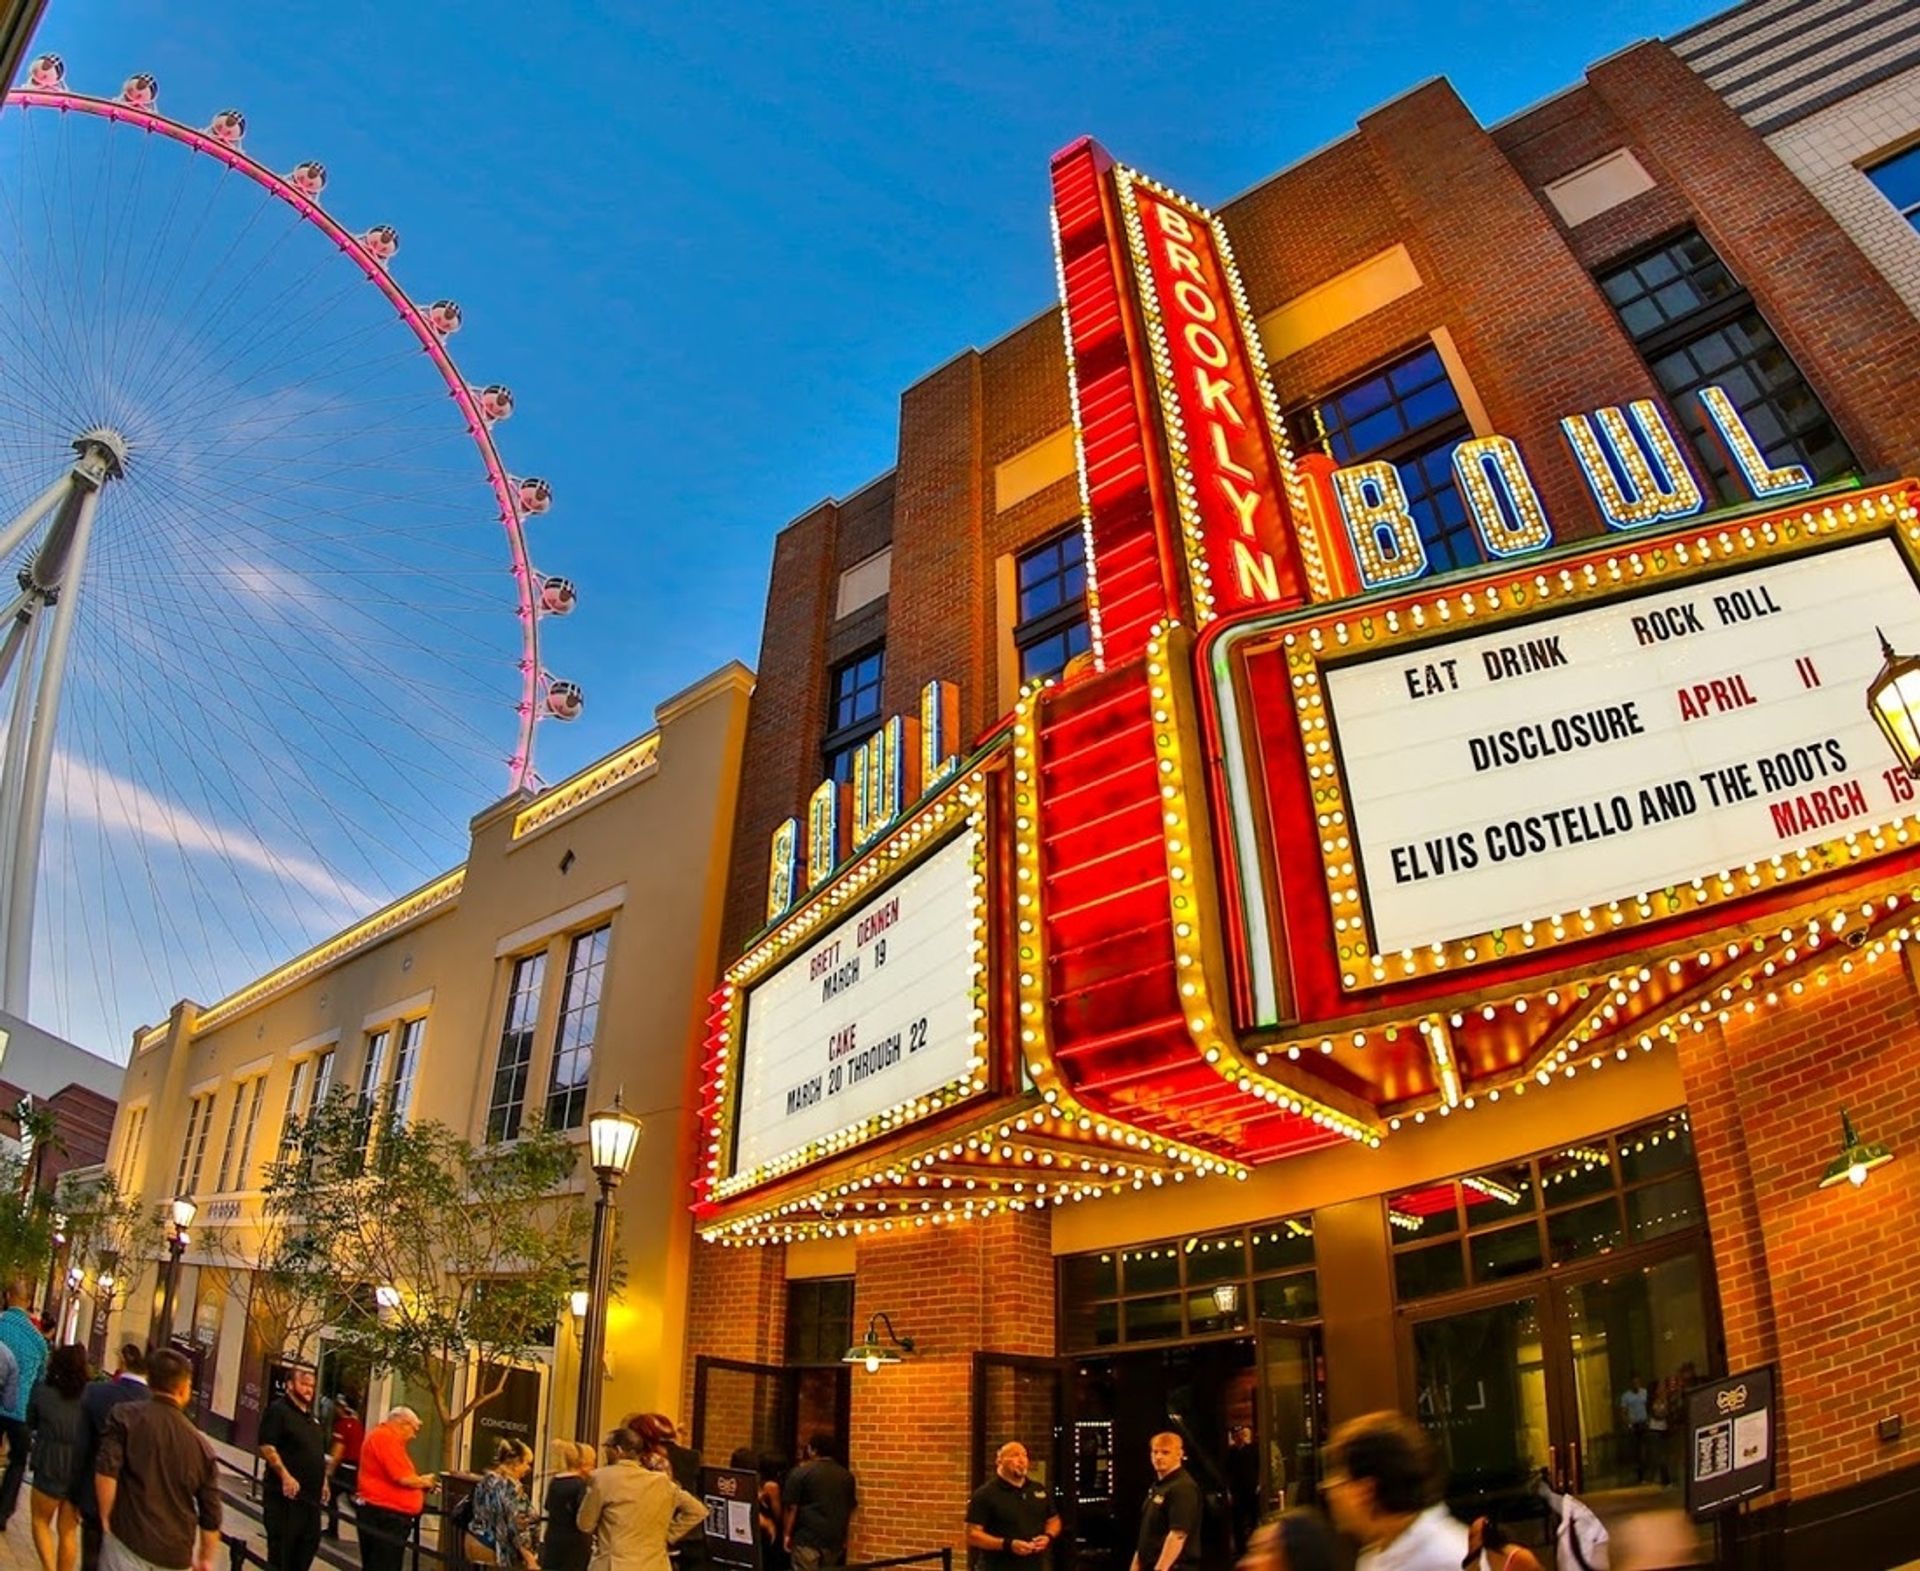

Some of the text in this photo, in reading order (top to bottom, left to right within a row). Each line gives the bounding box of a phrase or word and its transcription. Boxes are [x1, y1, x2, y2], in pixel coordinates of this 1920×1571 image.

[1155, 203, 1280, 600] BROOKLYN
[1331, 386, 1814, 590] BOWL
[1404, 586, 1781, 699] EAT DRINK ROCK ROLL
[1468, 702, 1645, 771] DISCLOSURE
[1677, 675, 1757, 721] APRIL
[766, 680, 958, 928] BOWL
[1390, 739, 1847, 884] ELVIS COSTELLO AND THE ROOTS
[1770, 766, 1914, 839] MARCH 15
[810, 896, 899, 981] BRETT DENNEN
[822, 938, 886, 1003] MARCH 19
[786, 1017, 927, 1115] MARCH 20 THROUGH 22
[829, 1023, 857, 1061] CAKE
